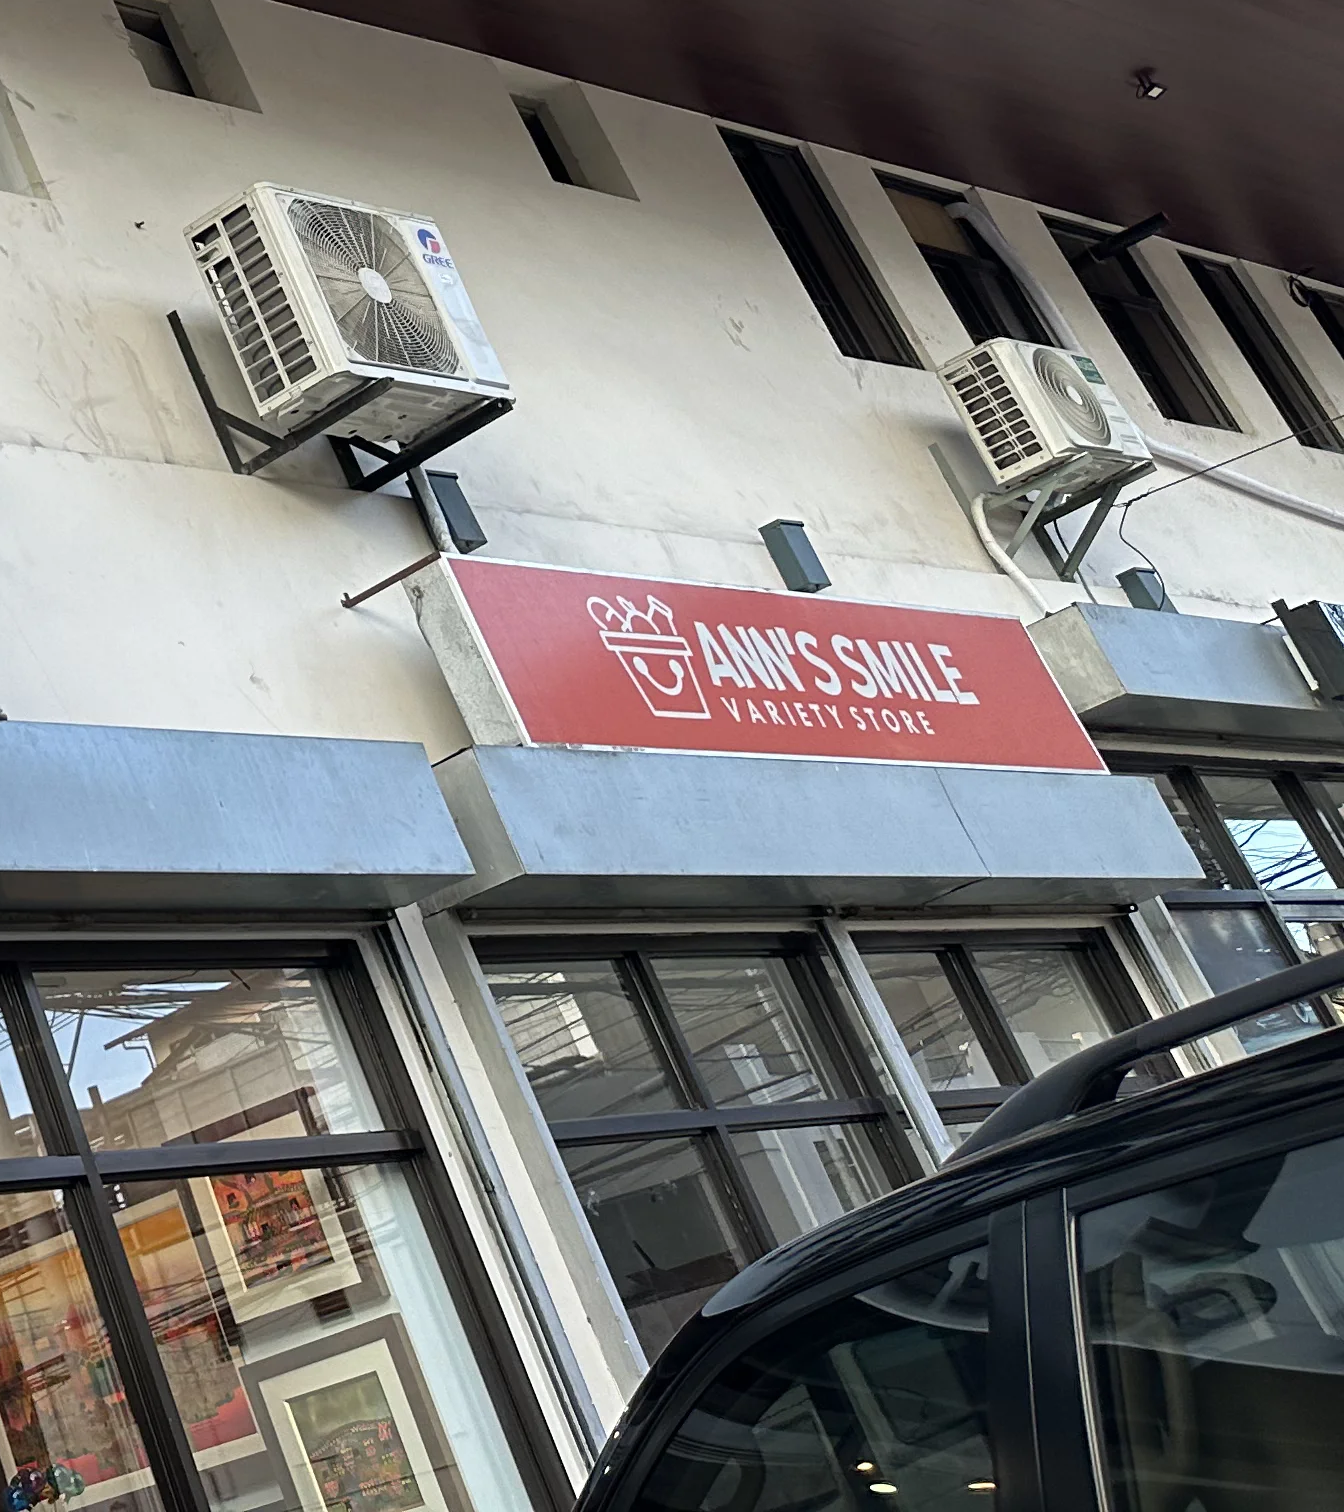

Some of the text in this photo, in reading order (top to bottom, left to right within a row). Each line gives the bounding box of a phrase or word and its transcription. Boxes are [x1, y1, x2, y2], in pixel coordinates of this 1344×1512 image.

[422, 253, 455, 269] GREE
[693, 620, 980, 705] ANN'S SMILE
[720, 696, 936, 735] VARIETY STORE
